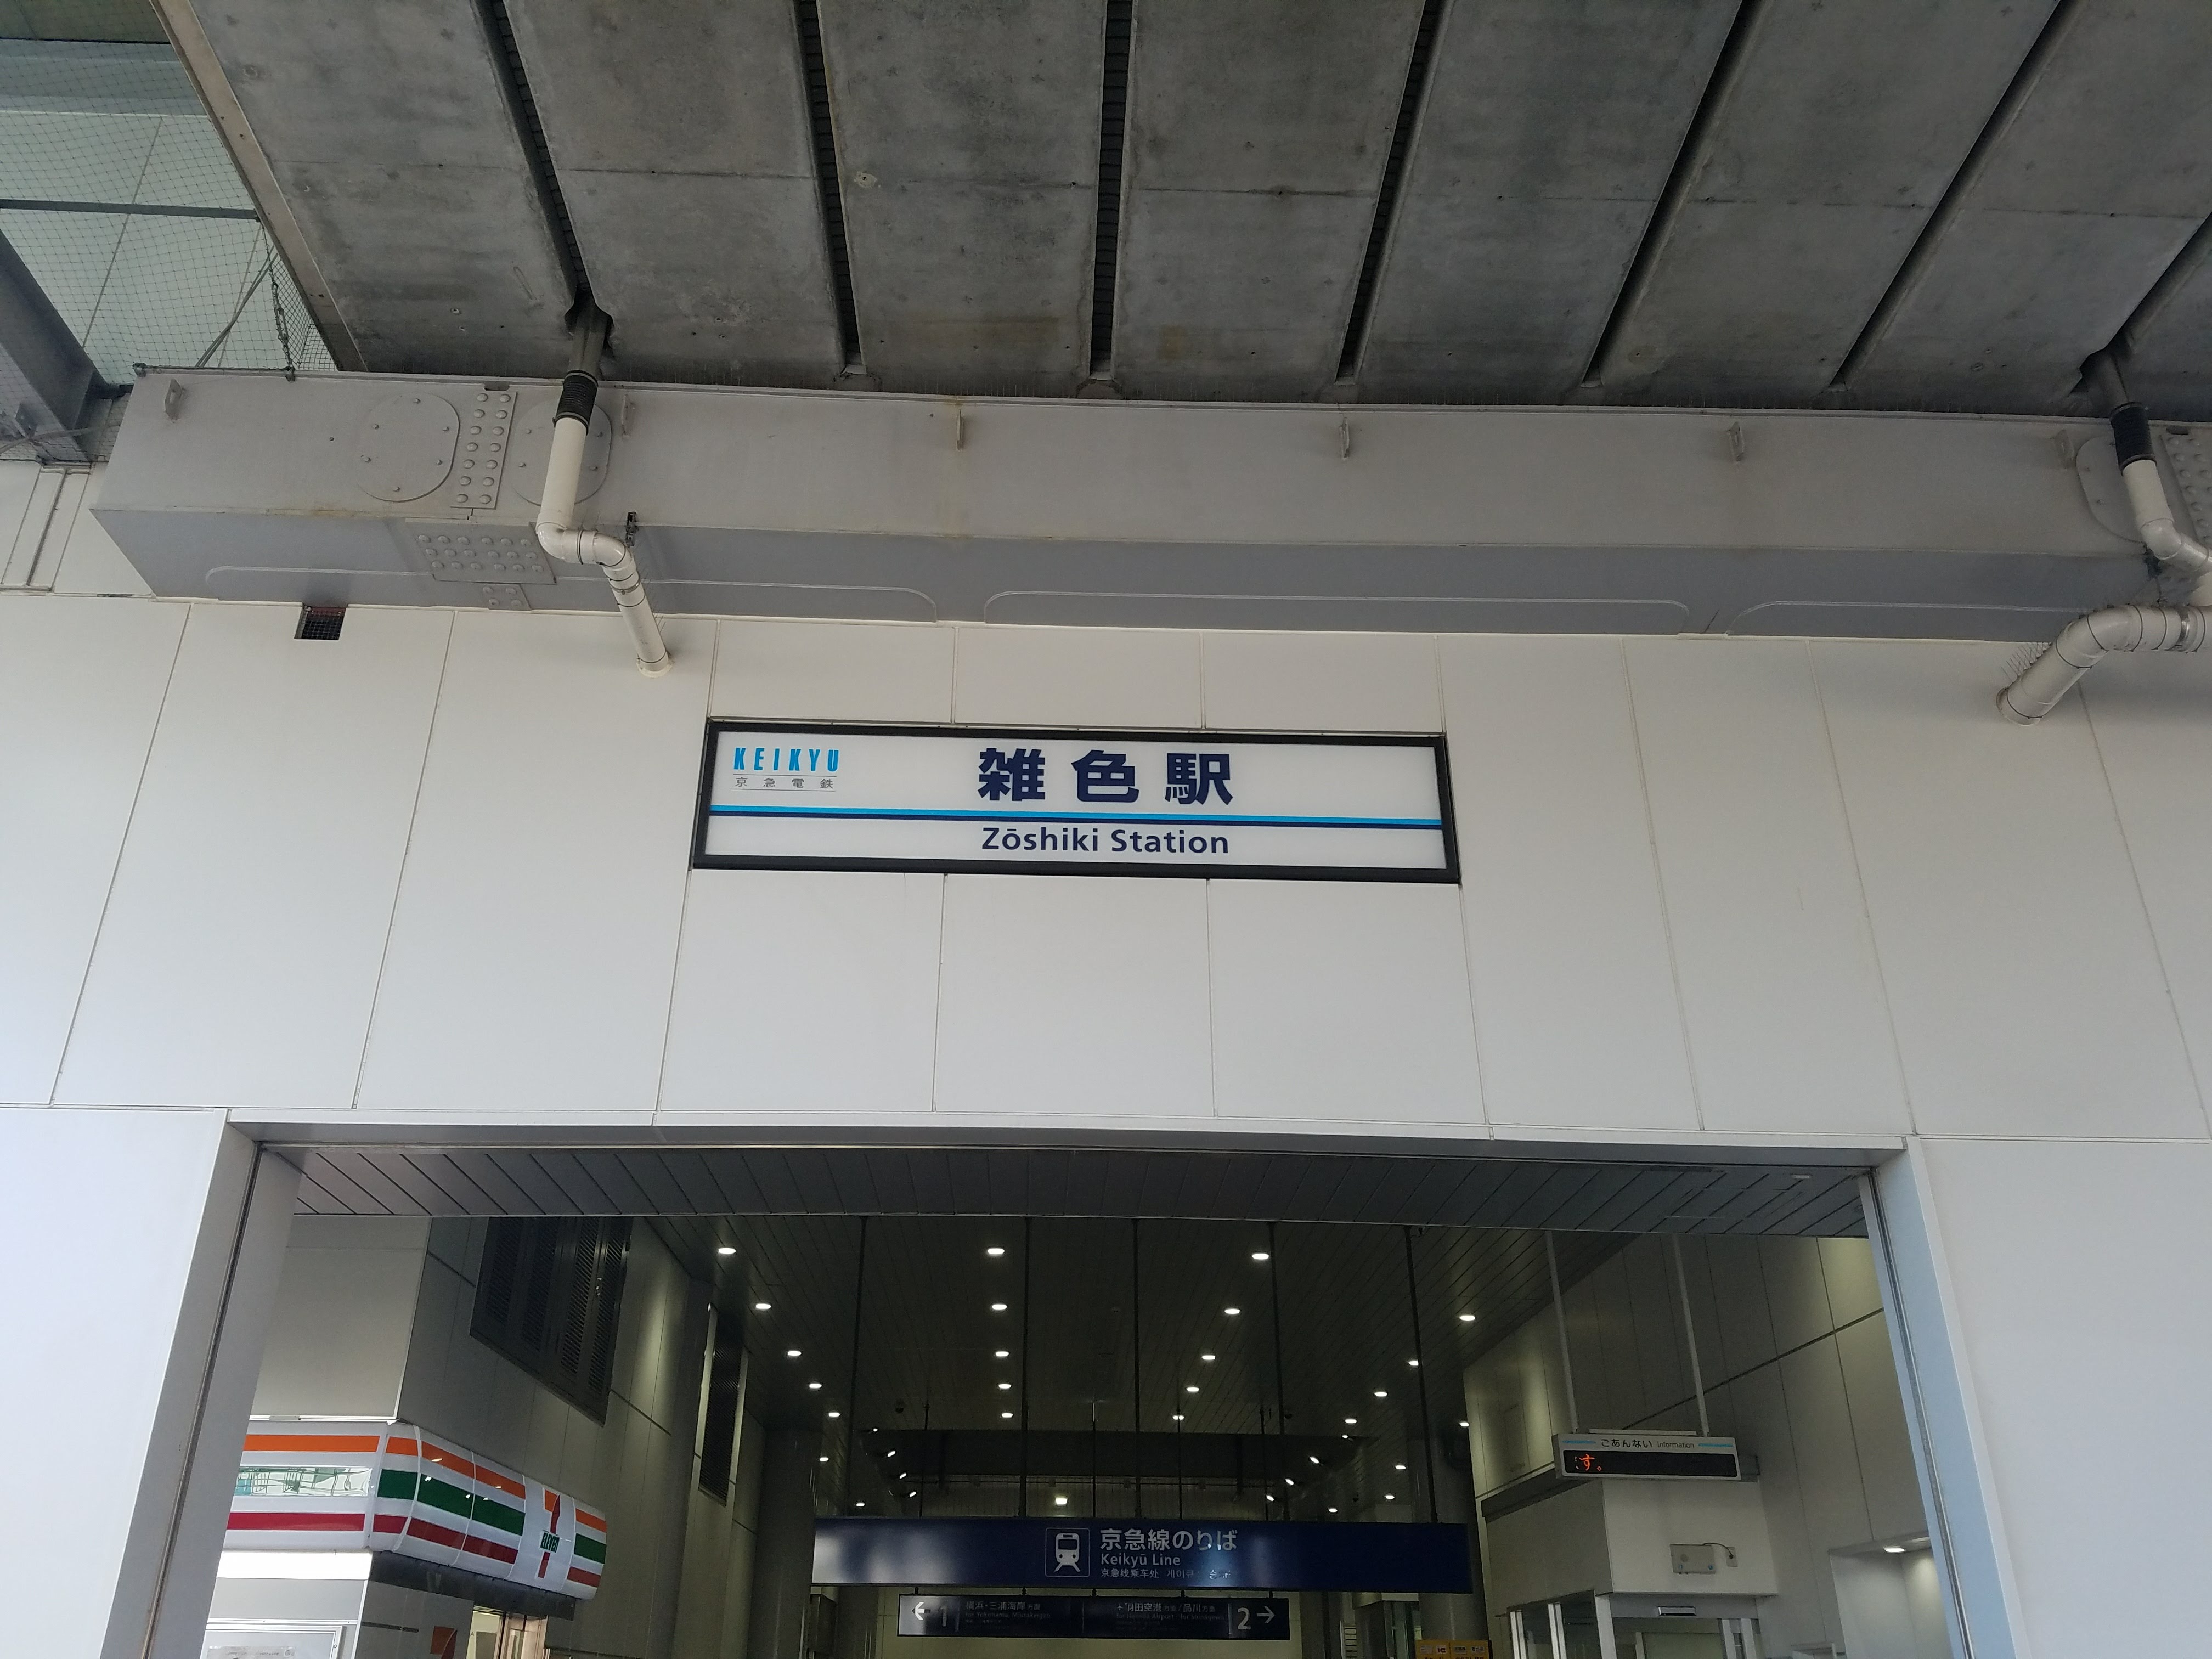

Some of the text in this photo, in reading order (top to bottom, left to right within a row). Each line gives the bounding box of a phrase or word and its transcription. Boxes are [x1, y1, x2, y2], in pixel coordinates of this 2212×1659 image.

[733, 747, 839, 772] KEIKYU
[735, 777, 834, 789] 京急電鉄
[977, 747, 1234, 805] 雑色駅
[981, 826, 1228, 854] Zōshiki Station
[1601, 1438, 1653, 1448] ごあんない
[1657, 1441, 1695, 1449] Information
[1099, 1528, 1238, 1551] 京急線のりば
[1101, 1553, 1181, 1568] Keikyū Line
[1238, 1607, 1251, 1630] 2
